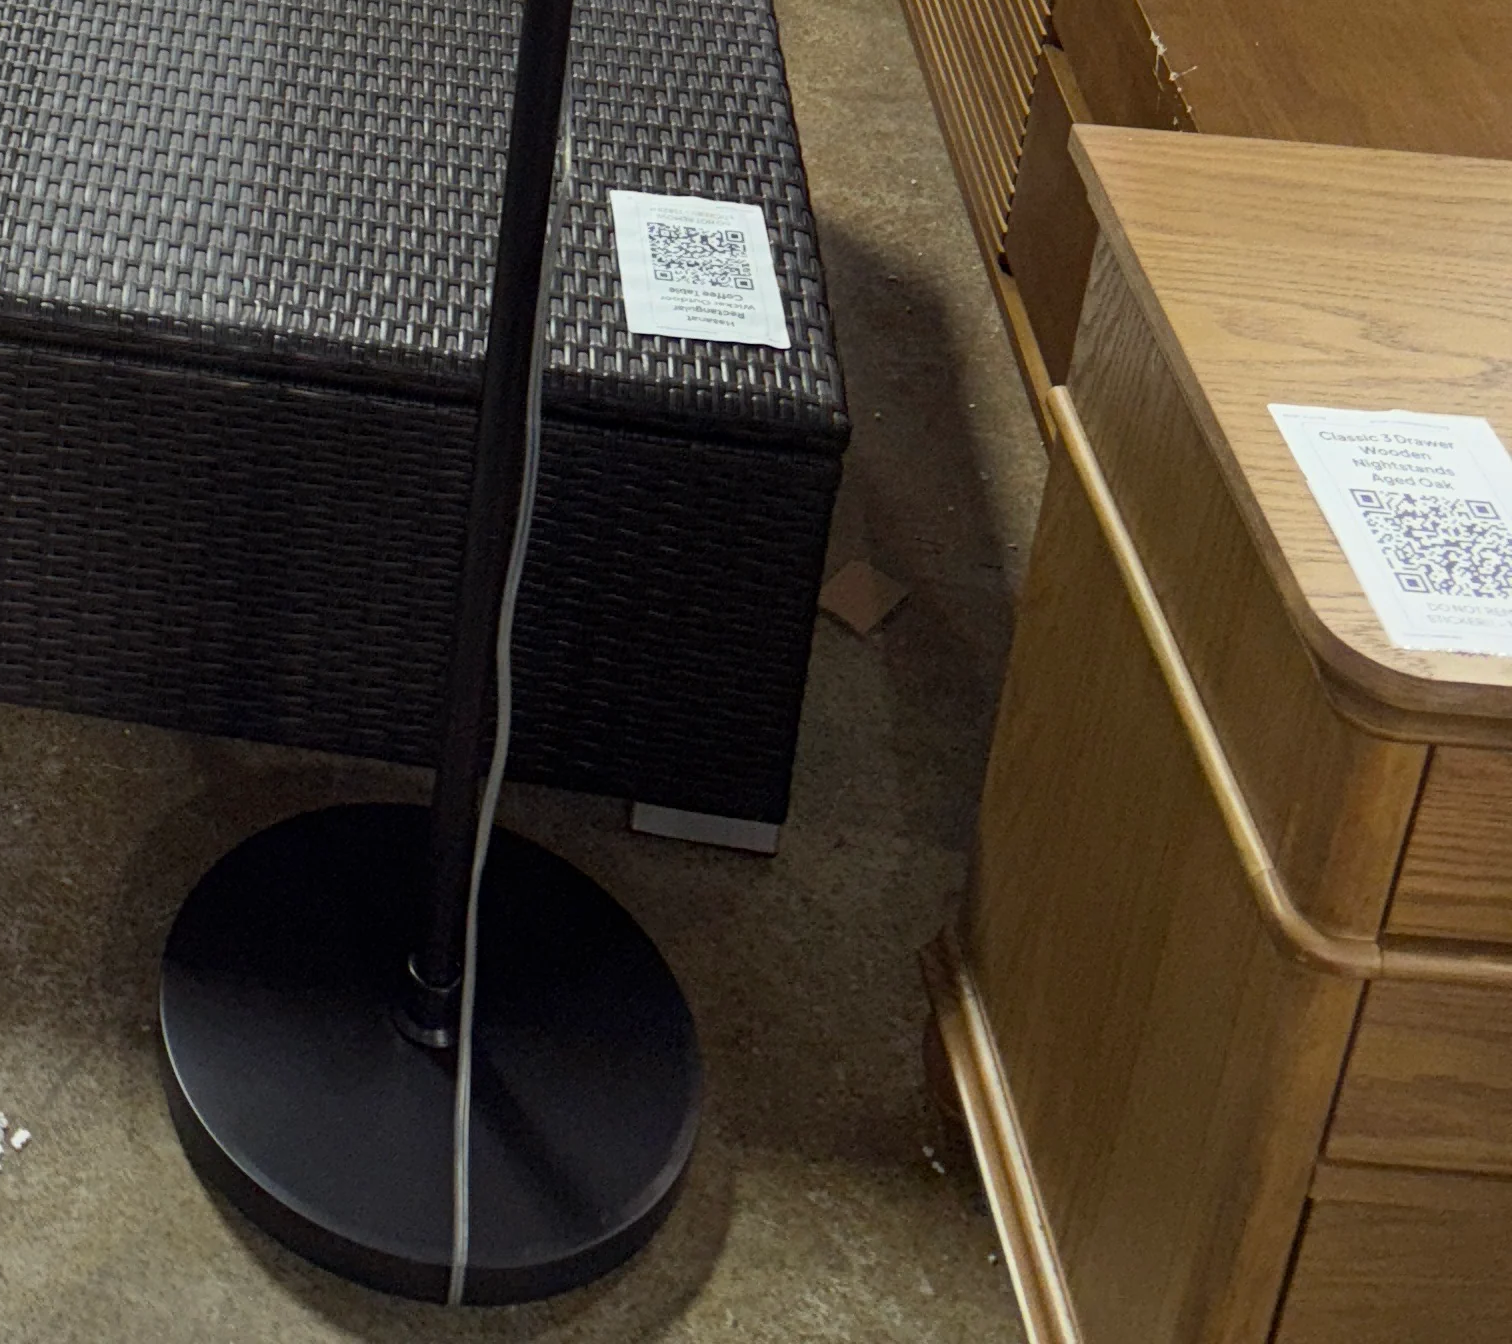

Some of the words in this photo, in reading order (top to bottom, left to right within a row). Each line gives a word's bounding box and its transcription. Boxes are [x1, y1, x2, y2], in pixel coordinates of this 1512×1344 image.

[668, 286, 701, 298] Table
[701, 289, 744, 303] Coffee
[672, 304, 746, 320] Rectangular
[1318, 430, 1379, 444] Classic
[1382, 433, 1392, 443] 3
[1393, 433, 1455, 450] Drawer
[1359, 444, 1432, 461] Wooden
[1351, 457, 1456, 478] Nightstands
[1371, 472, 1417, 488] Aged
[1419, 477, 1455, 491] Oak
